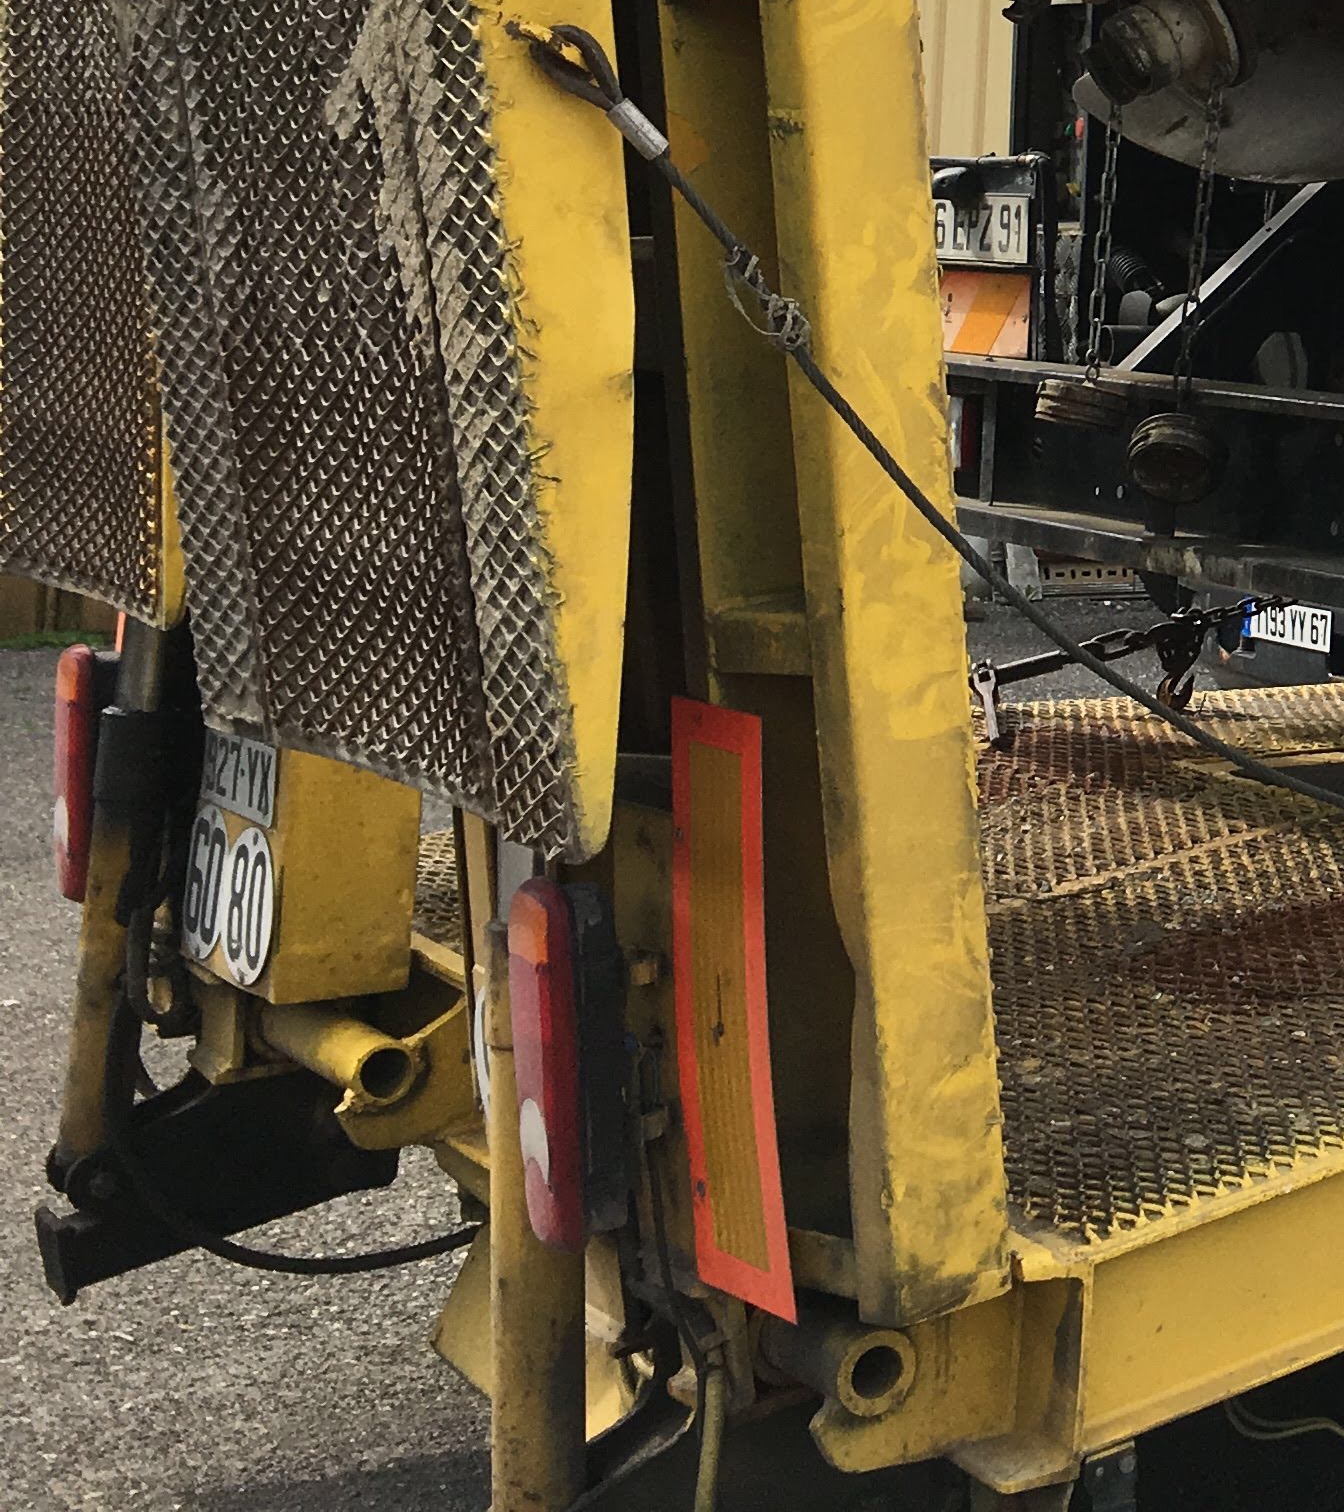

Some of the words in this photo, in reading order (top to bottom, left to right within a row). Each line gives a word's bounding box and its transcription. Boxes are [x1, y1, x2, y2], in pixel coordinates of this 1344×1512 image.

[998, 204, 1022, 253] 91
[1290, 609, 1307, 642] YY
[1311, 613, 1328, 646] 67
[185, 817, 226, 946] 60
[226, 843, 267, 971] 80
